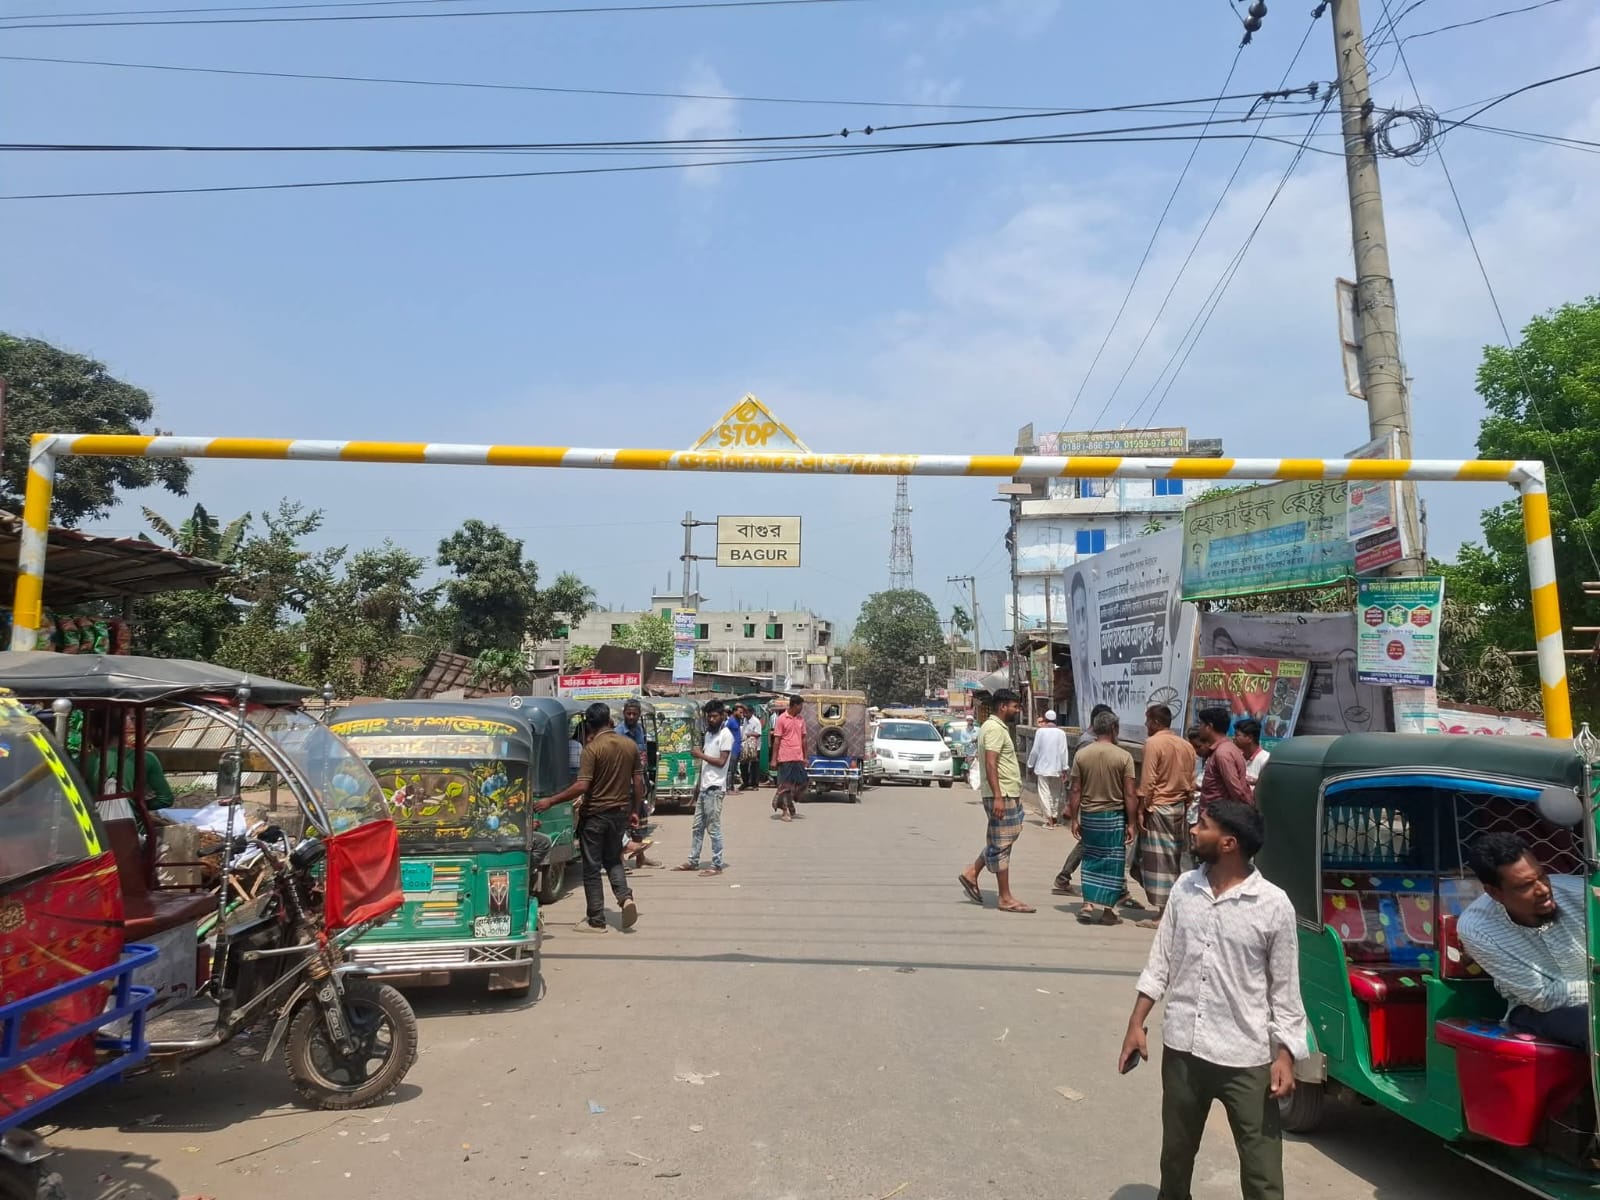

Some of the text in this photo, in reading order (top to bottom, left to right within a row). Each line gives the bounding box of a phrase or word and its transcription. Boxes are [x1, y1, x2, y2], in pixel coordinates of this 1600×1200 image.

[719, 421, 777, 447] STOP
[1168, 438, 1183, 447] 400
[1189, 500, 1275, 536] হোসাইন
[735, 522, 782, 539] বাগুর
[729, 548, 788, 561] BAGUR
